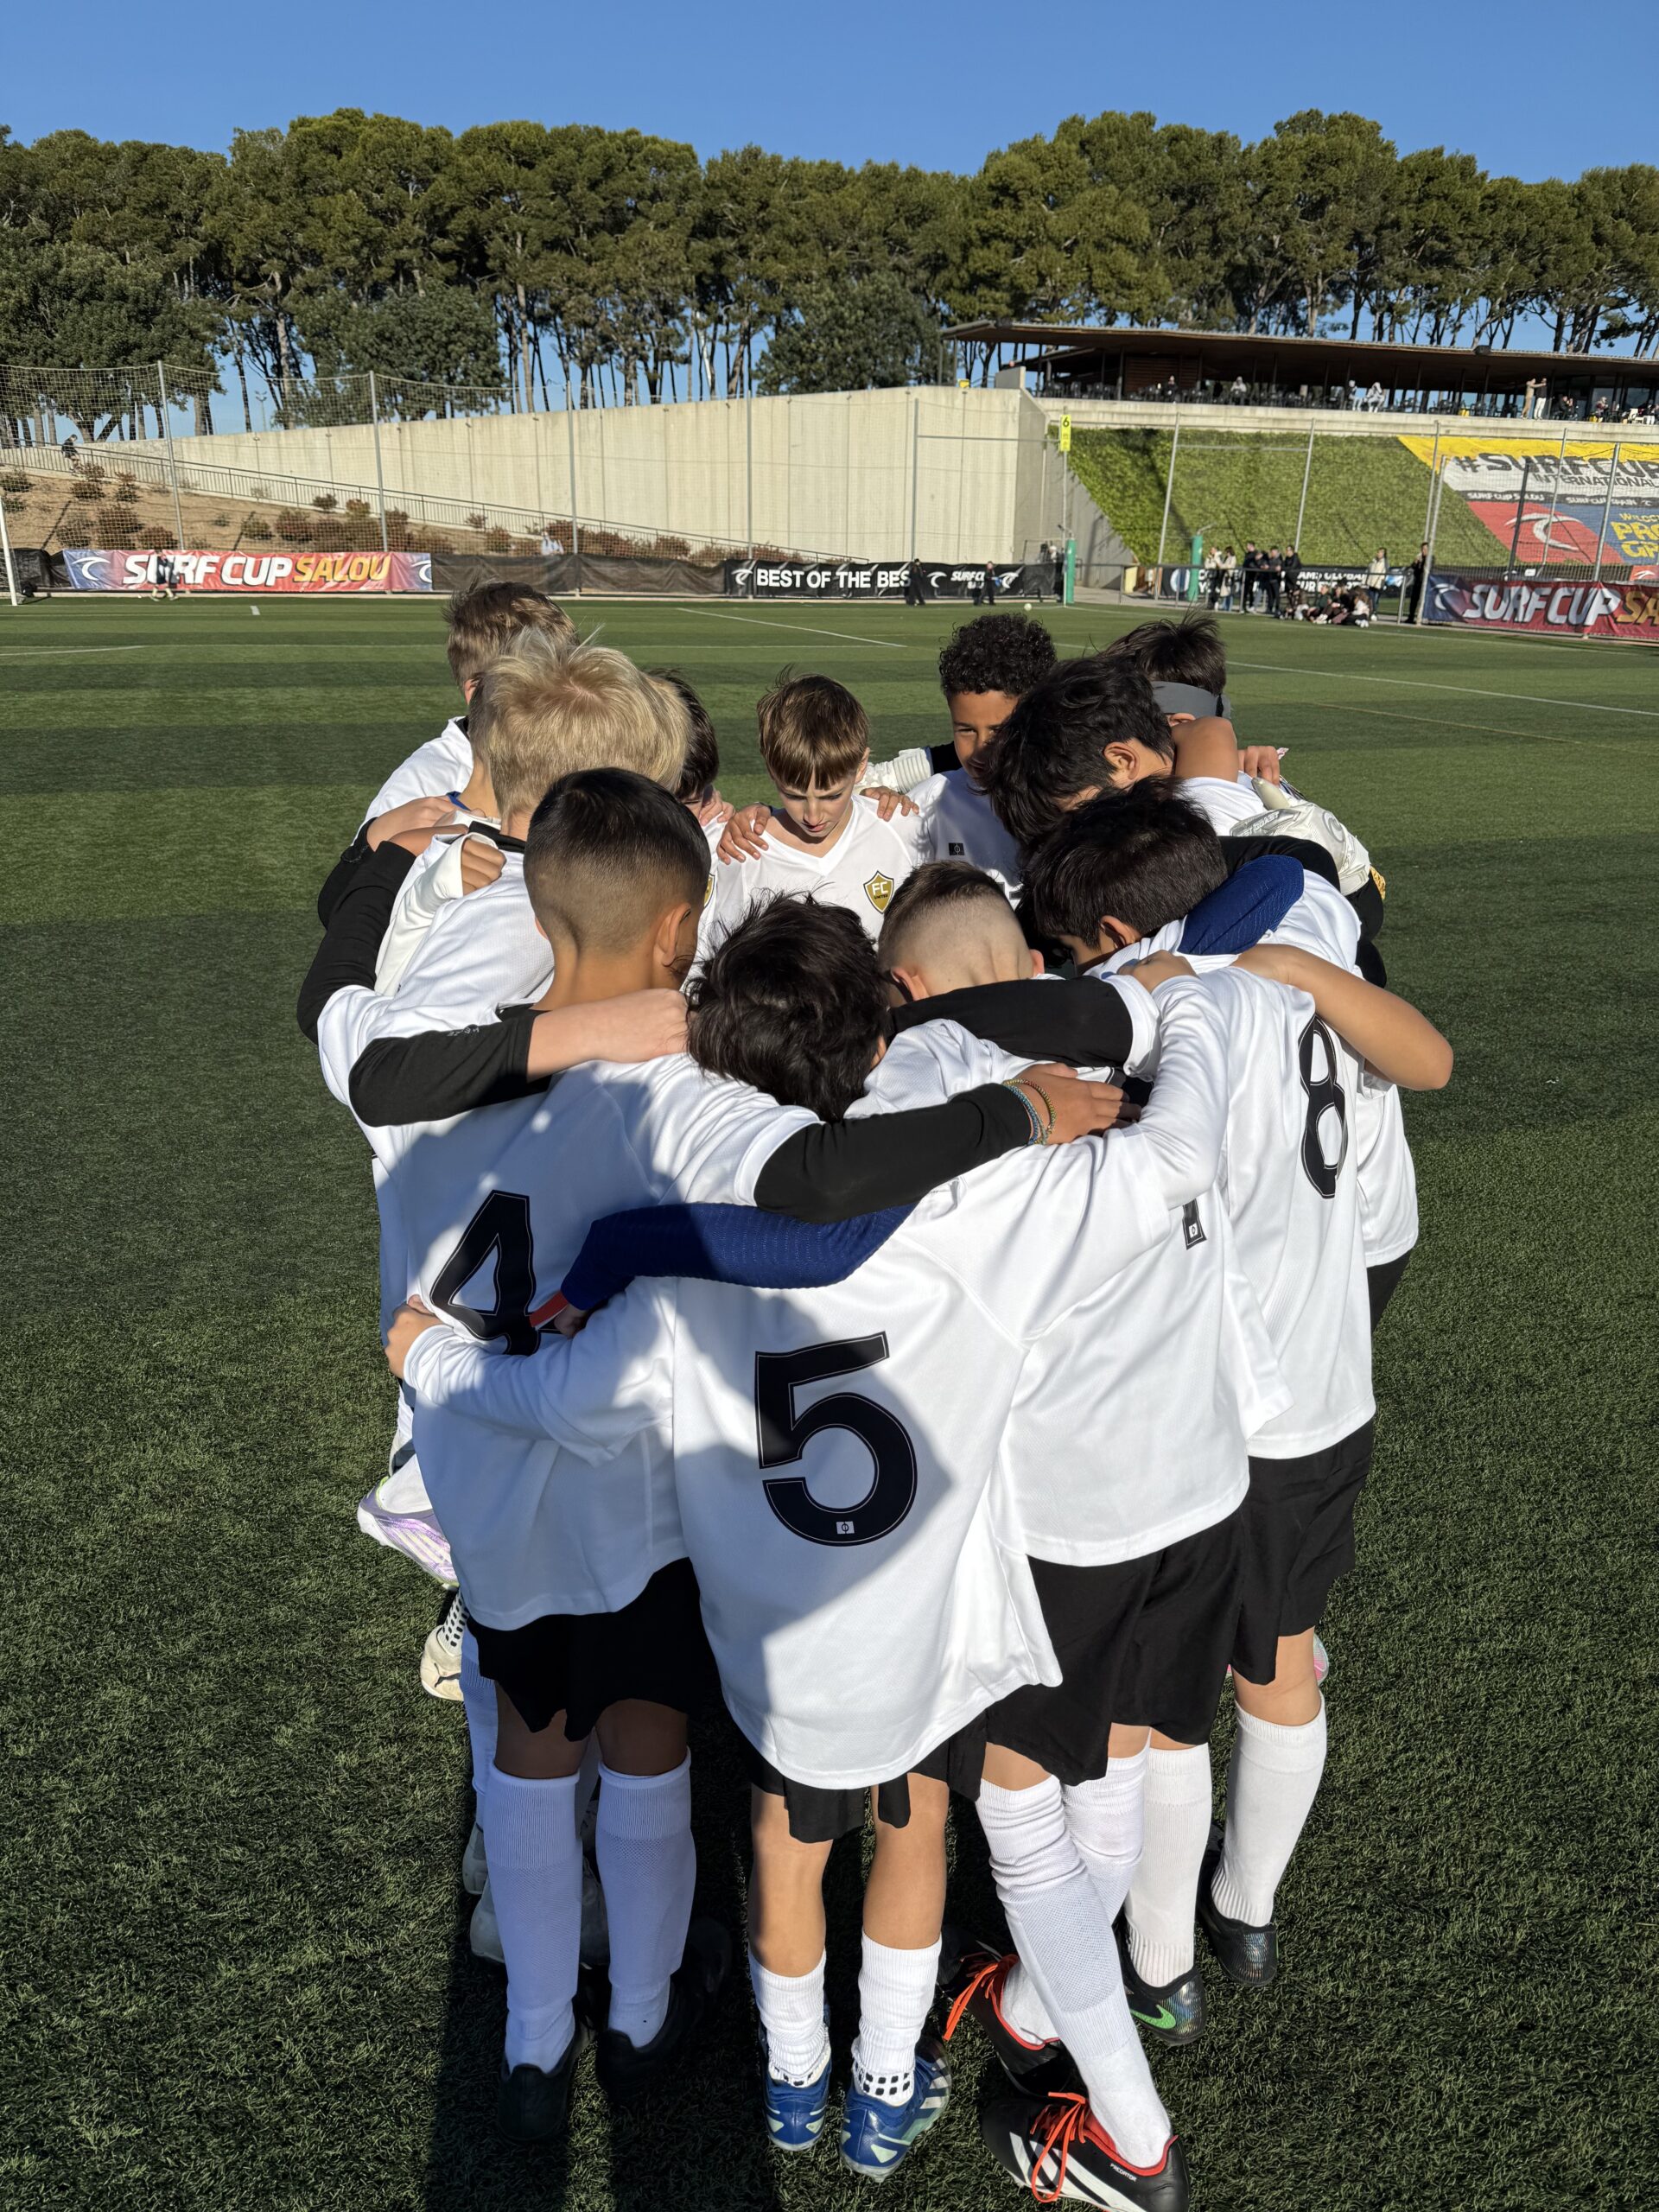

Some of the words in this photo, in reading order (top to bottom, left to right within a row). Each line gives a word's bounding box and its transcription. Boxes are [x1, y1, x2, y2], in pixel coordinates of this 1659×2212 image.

[1063, 416, 1070, 428] 6
[221, 556, 292, 586] CUP
[294, 556, 391, 582] SALOU
[757, 569, 804, 588] BEST
[806, 570, 831, 588] OF
[836, 571, 871, 588] THE
[877, 570, 911, 588] BES
[1462, 583, 1552, 623] SURF
[1548, 587, 1621, 626] CUP
[872, 881, 888, 896] FC
[1298, 1014, 1348, 1199] 8
[429, 1189, 566, 1356] 4
[754, 1331, 918, 1547] 5
[1109, 2163, 1137, 2183] PREDATOR
